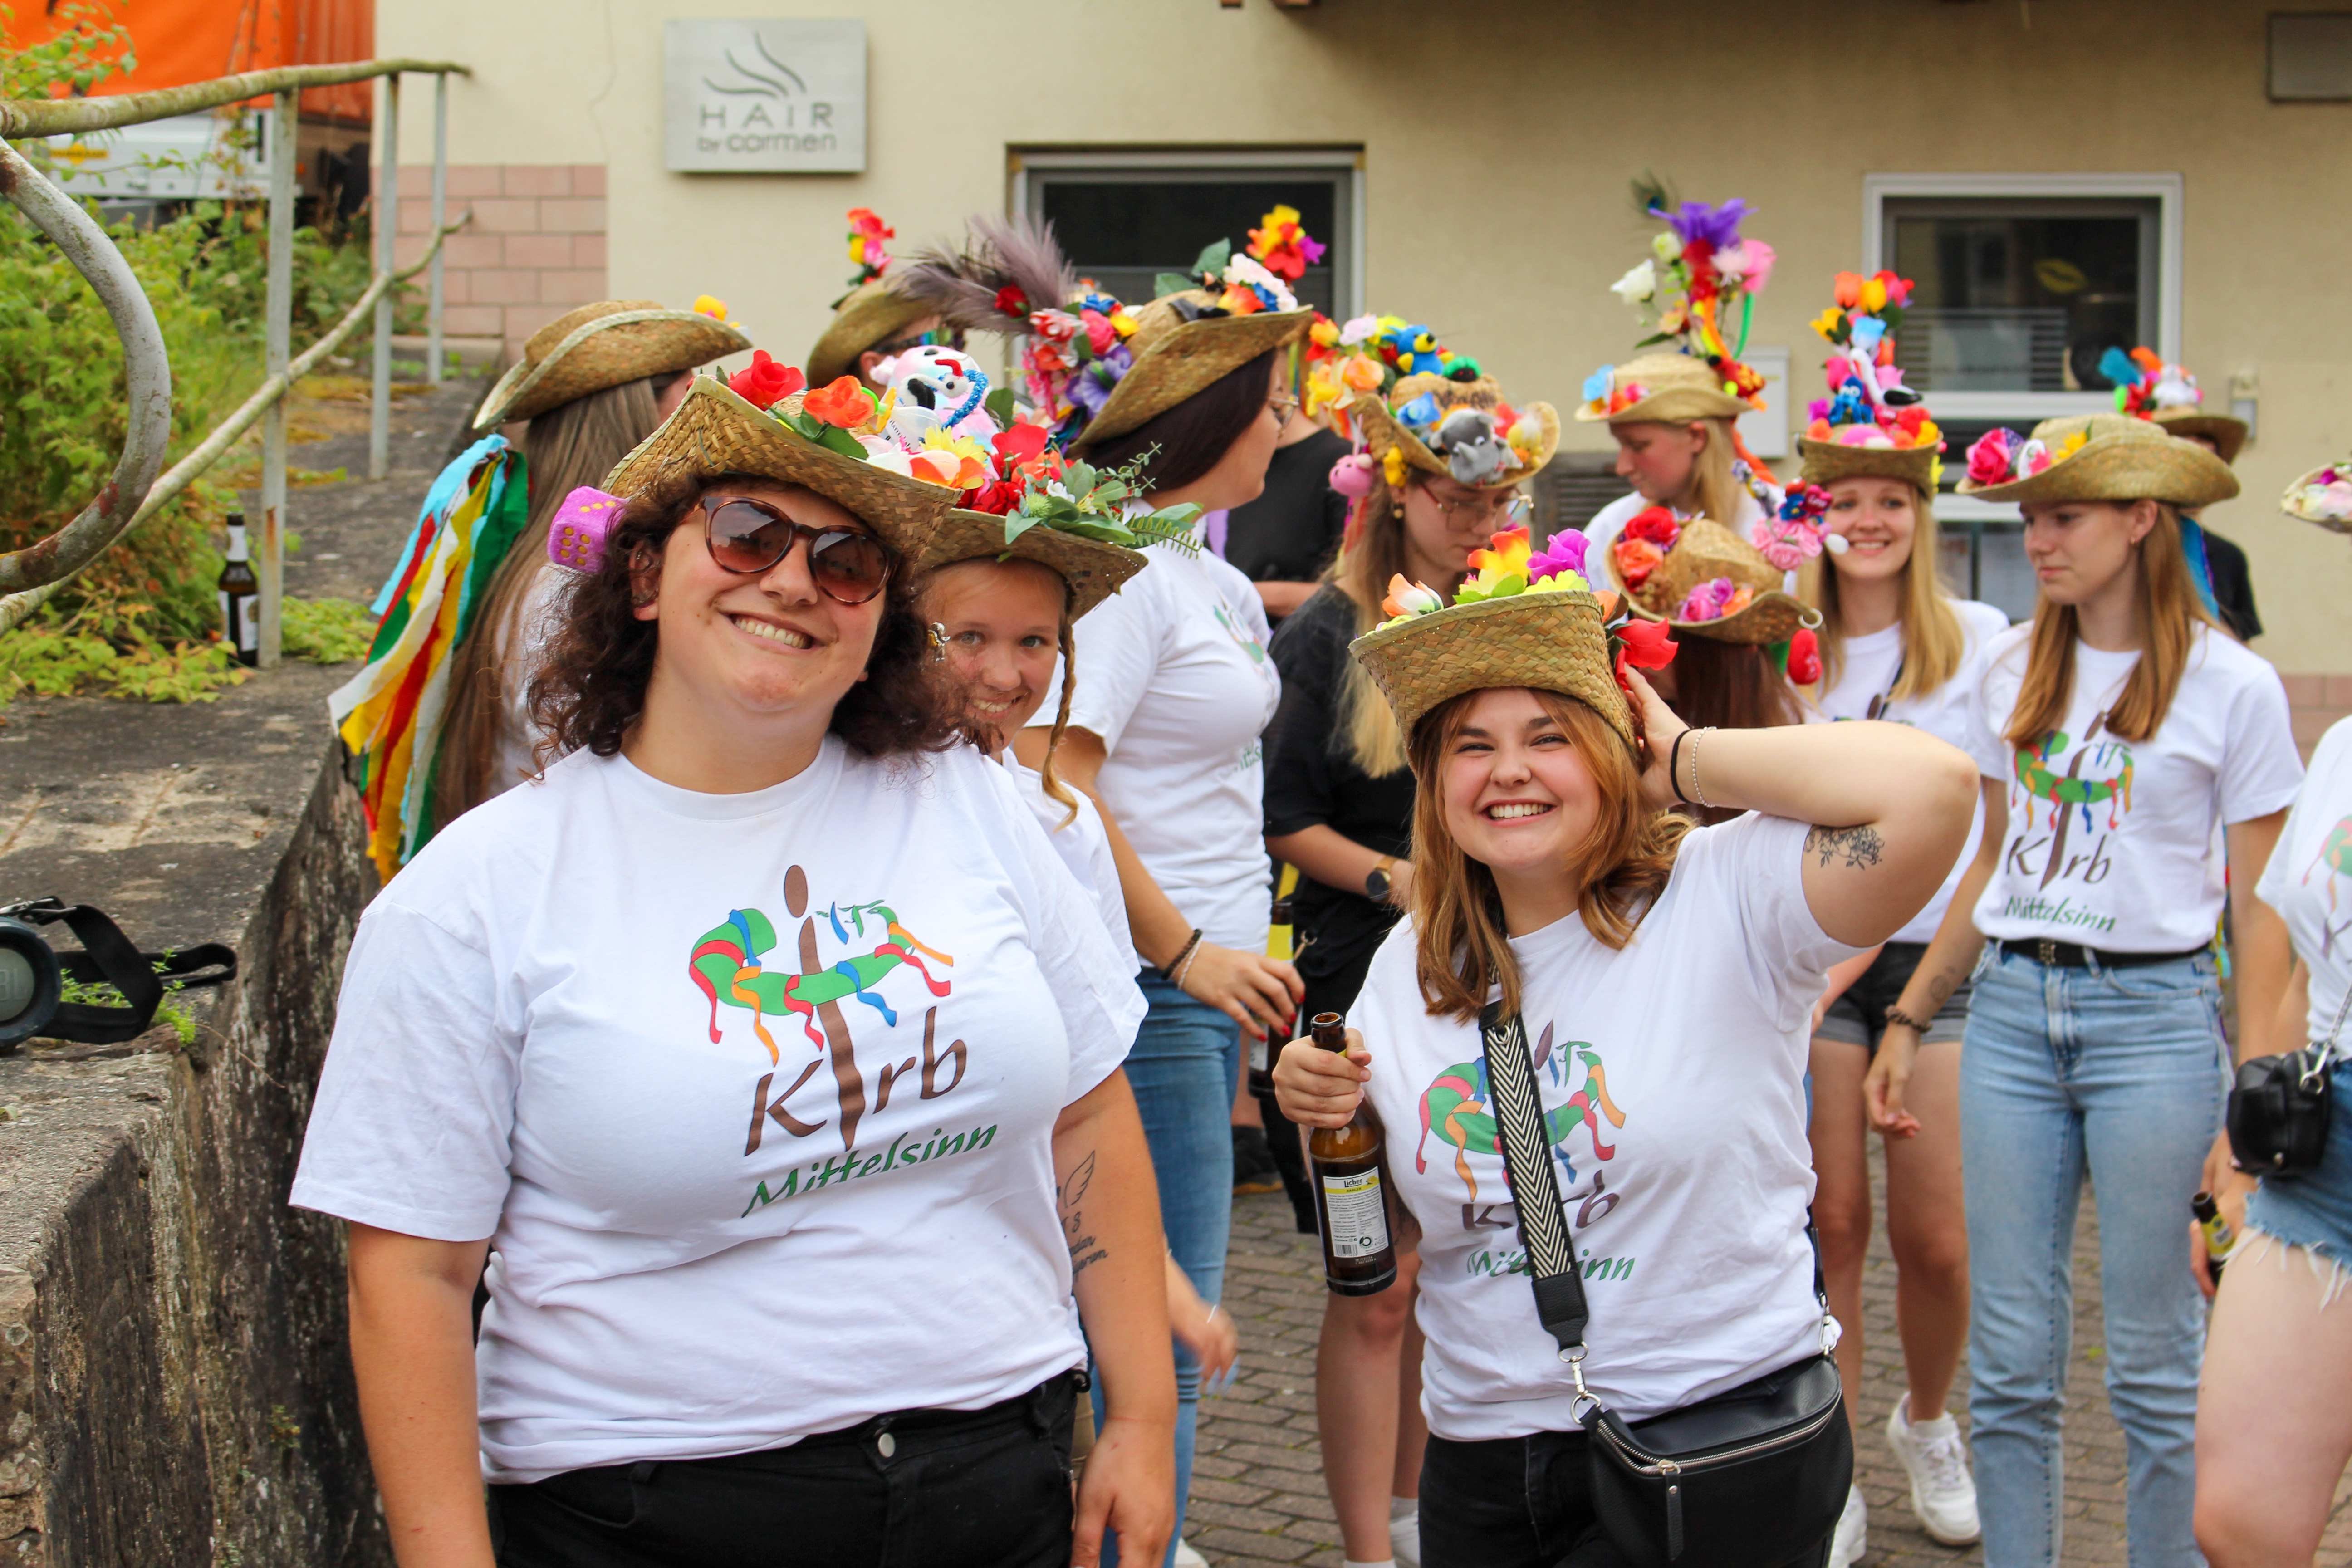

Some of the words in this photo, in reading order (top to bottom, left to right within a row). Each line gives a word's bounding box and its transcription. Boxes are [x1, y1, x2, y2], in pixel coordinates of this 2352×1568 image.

[700, 102, 833, 128] HAIR
[697, 136, 720, 153] by
[727, 133, 837, 152] carmen
[2004, 894, 2117, 932] Mittelsinn
[745, 1006, 967, 1156] Kirb
[741, 1124, 997, 1219] Mittelsinn
[1344, 1179, 1362, 1187] Licher
